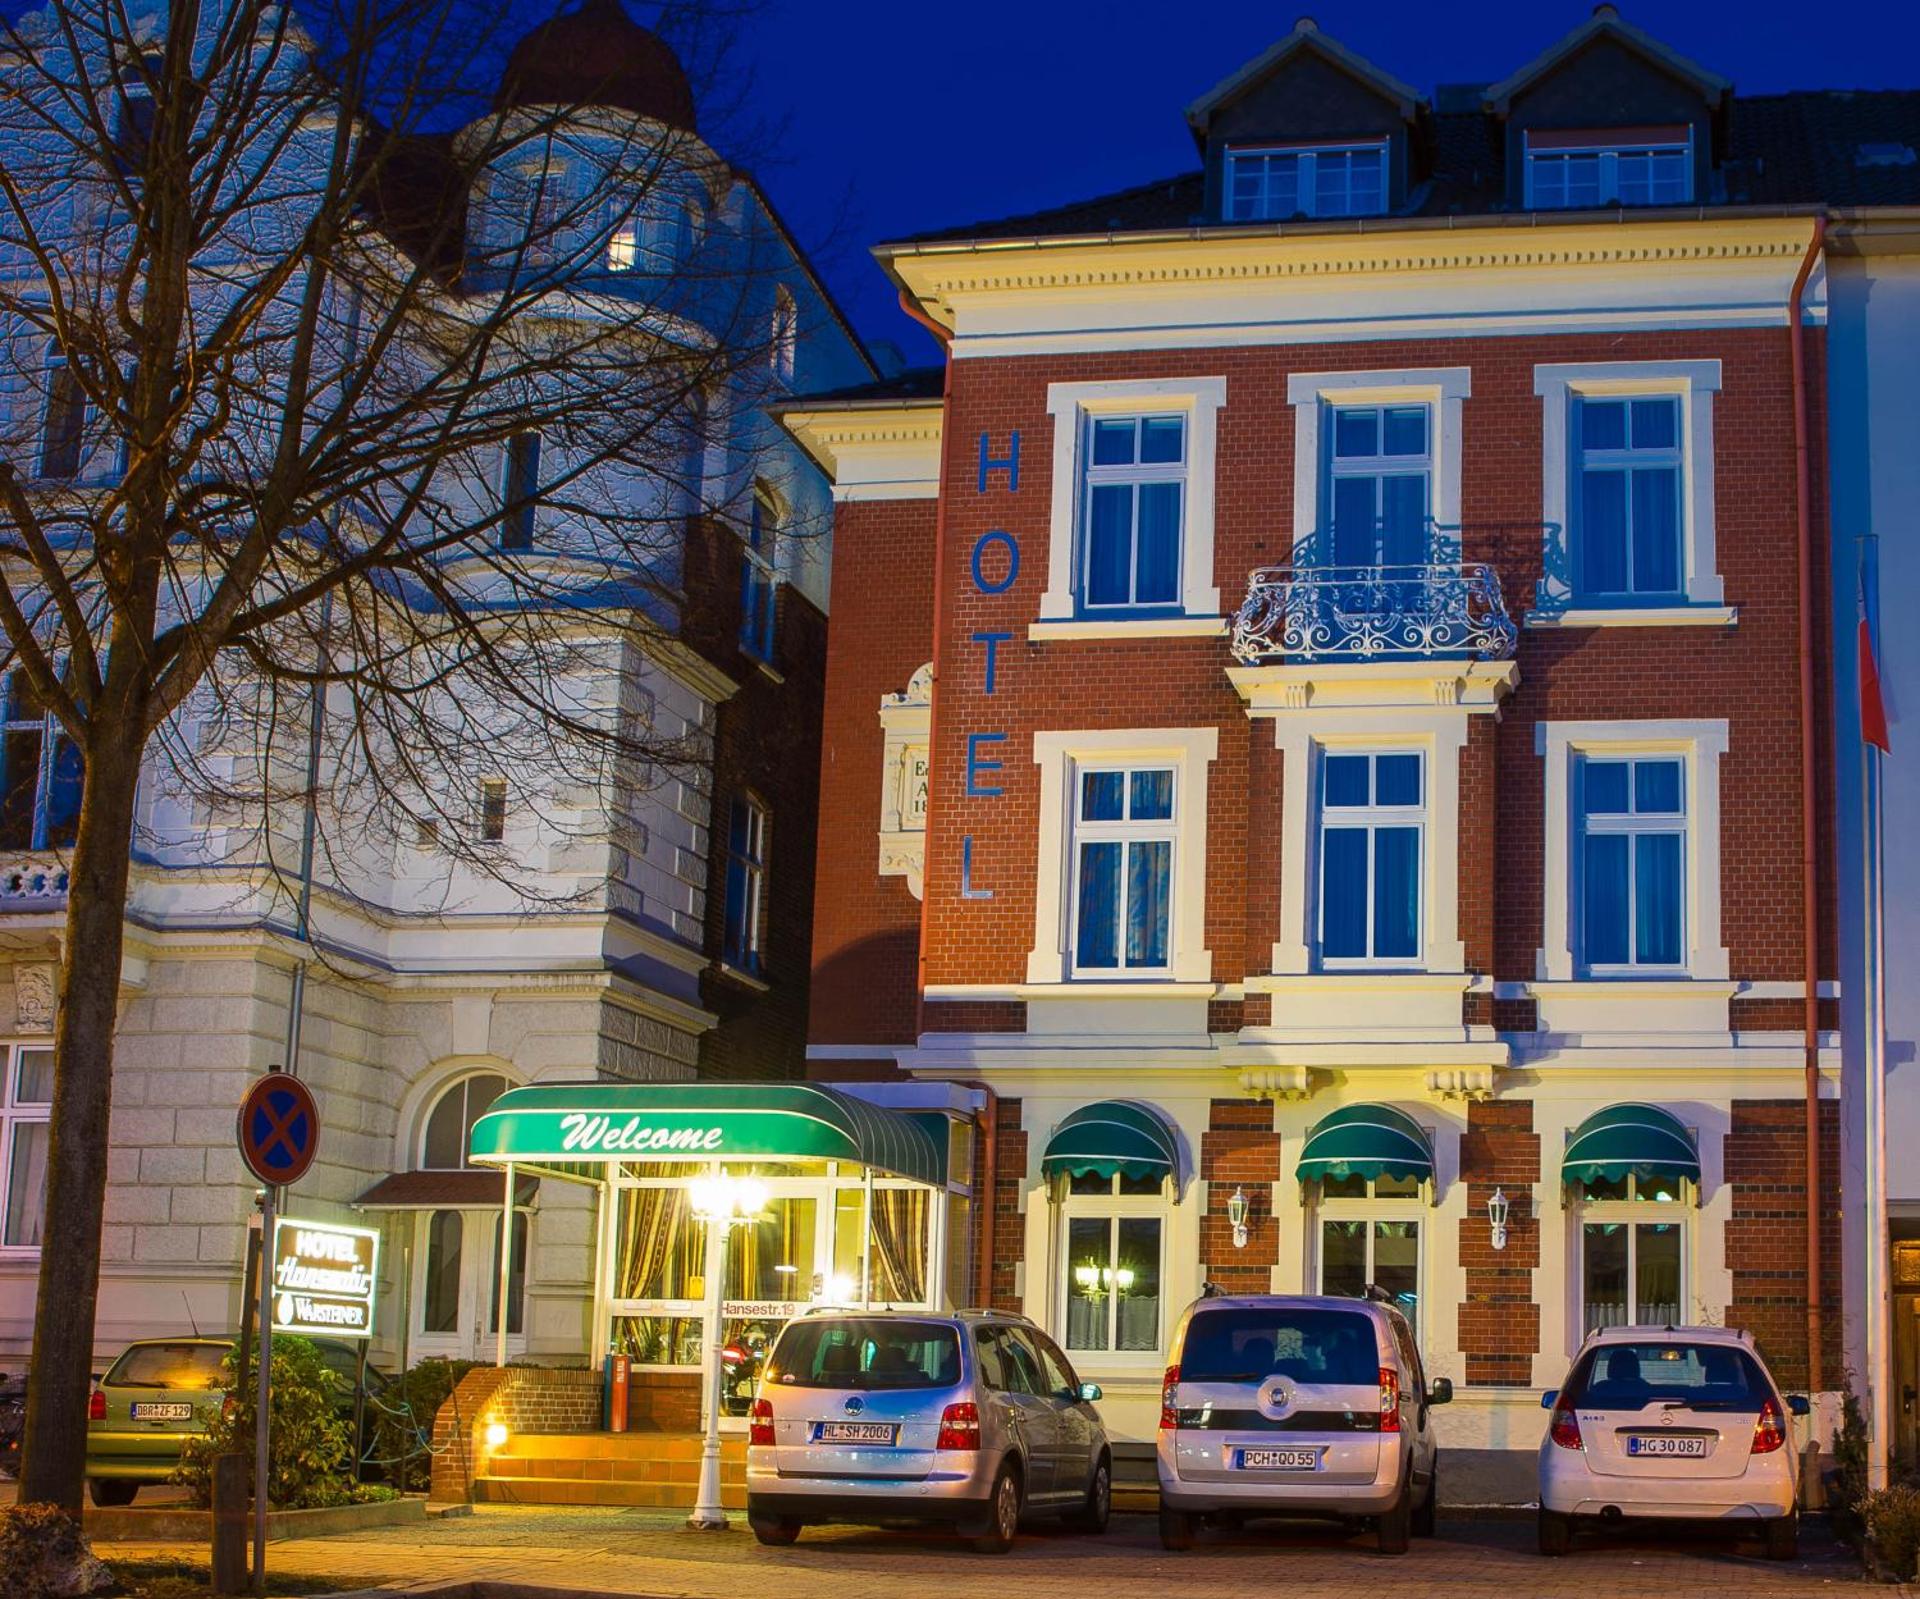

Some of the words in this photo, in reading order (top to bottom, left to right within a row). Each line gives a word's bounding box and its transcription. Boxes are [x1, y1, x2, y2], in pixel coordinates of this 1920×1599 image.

[962, 431, 1021, 899] HOTEL
[560, 1113, 723, 1150] Welcome
[295, 1230, 359, 1263] HOTEL
[173, 1405, 190, 1417] 129
[823, 1424, 838, 1438] HL
[845, 1425, 861, 1438] SH
[862, 1425, 890, 1439] 2006
[1638, 1441, 1657, 1452] HG
[1660, 1441, 1675, 1453] 30
[1678, 1441, 1703, 1453] 087
[1245, 1451, 1271, 1465] PCH
[1297, 1452, 1314, 1466] 55
